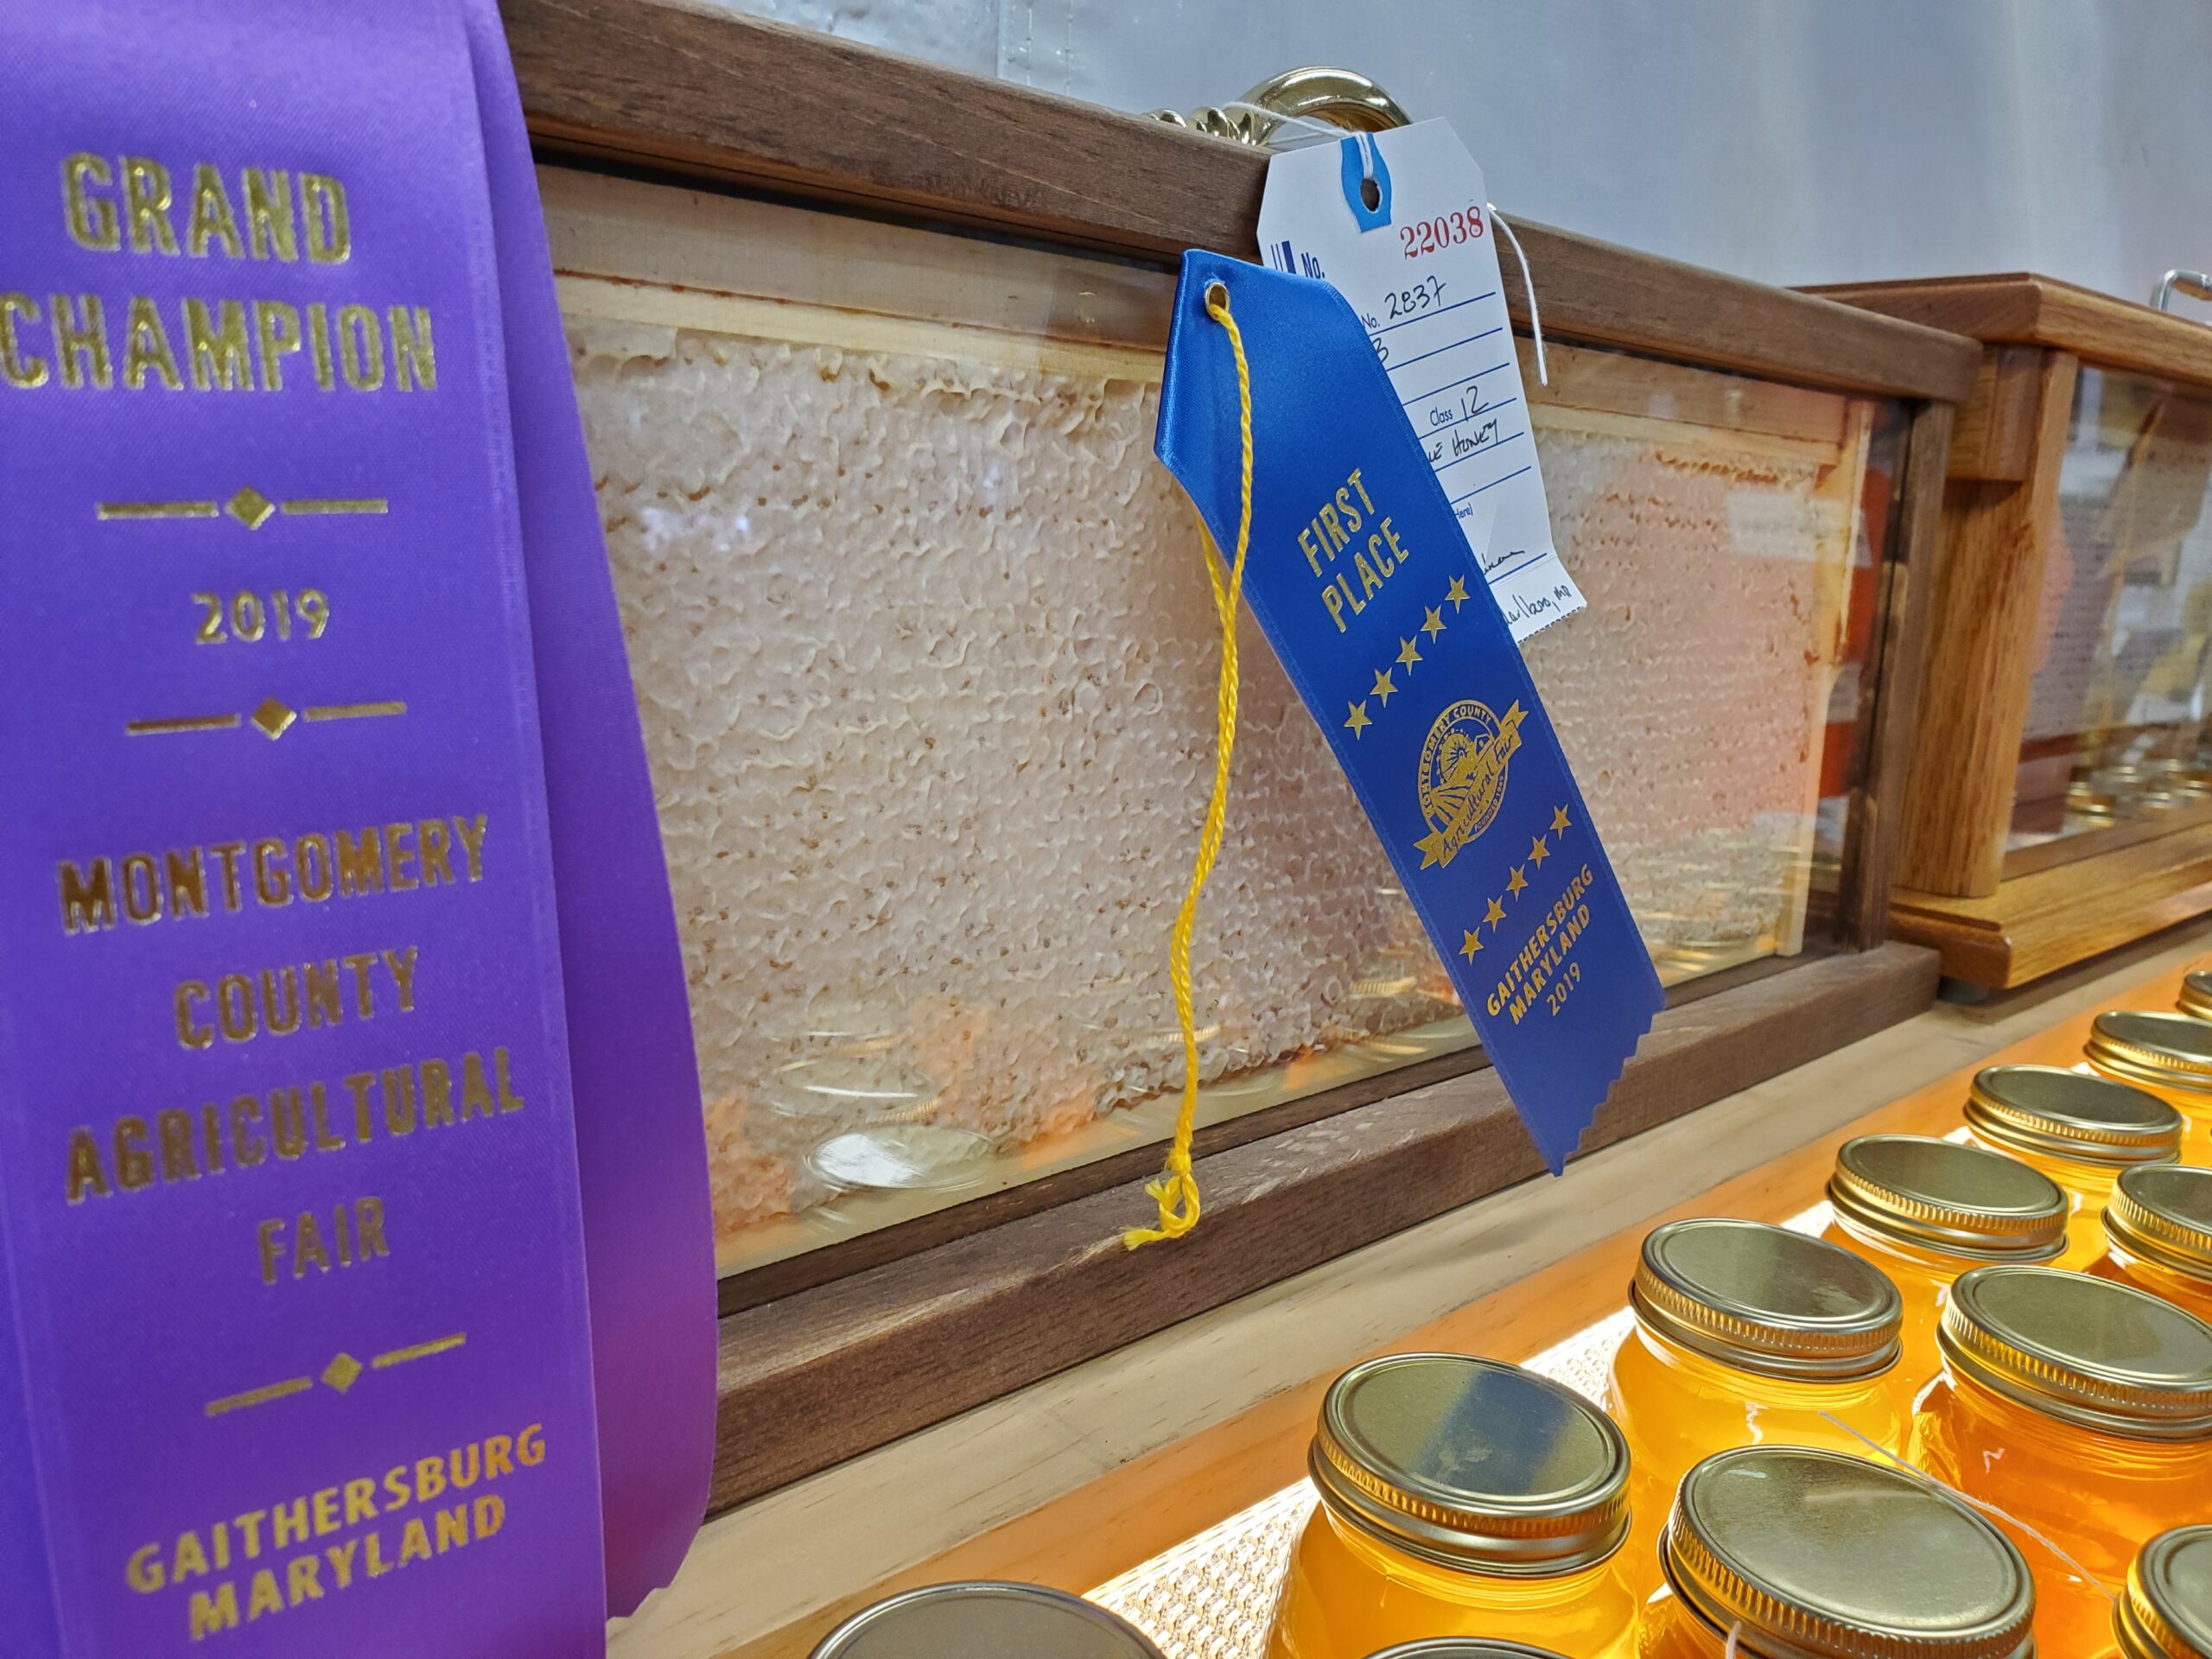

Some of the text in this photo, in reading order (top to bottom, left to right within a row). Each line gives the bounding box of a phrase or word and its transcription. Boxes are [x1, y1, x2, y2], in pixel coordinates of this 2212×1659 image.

[60, 151, 351, 265] GRAND
[1400, 207, 1484, 259] 22038
[1300, 251, 1325, 279] No.
[1385, 275, 1446, 320] 2837
[0, 292, 437, 392] CHAMPION
[1429, 385, 1490, 426] Class 12
[1297, 467, 1376, 577] FIRST
[1321, 516, 1409, 633] PLACE
[191, 588, 331, 645] 2019
[1453, 705, 1491, 724] COUNTY
[55, 813, 489, 936] MONTGOMERY
[1486, 863, 1593, 1016] GAITHERSBURG
[1509, 904, 1590, 1026] MARYLAND
[1547, 962, 1581, 1016] 2019
[175, 945, 418, 1052] COUNTY
[65, 1045, 524, 1206] AGRICULTURAL
[256, 1195, 391, 1287] FAIR
[124, 1421, 548, 1595] GAITHERSBURG
[188, 1492, 507, 1641] MARYLAND
